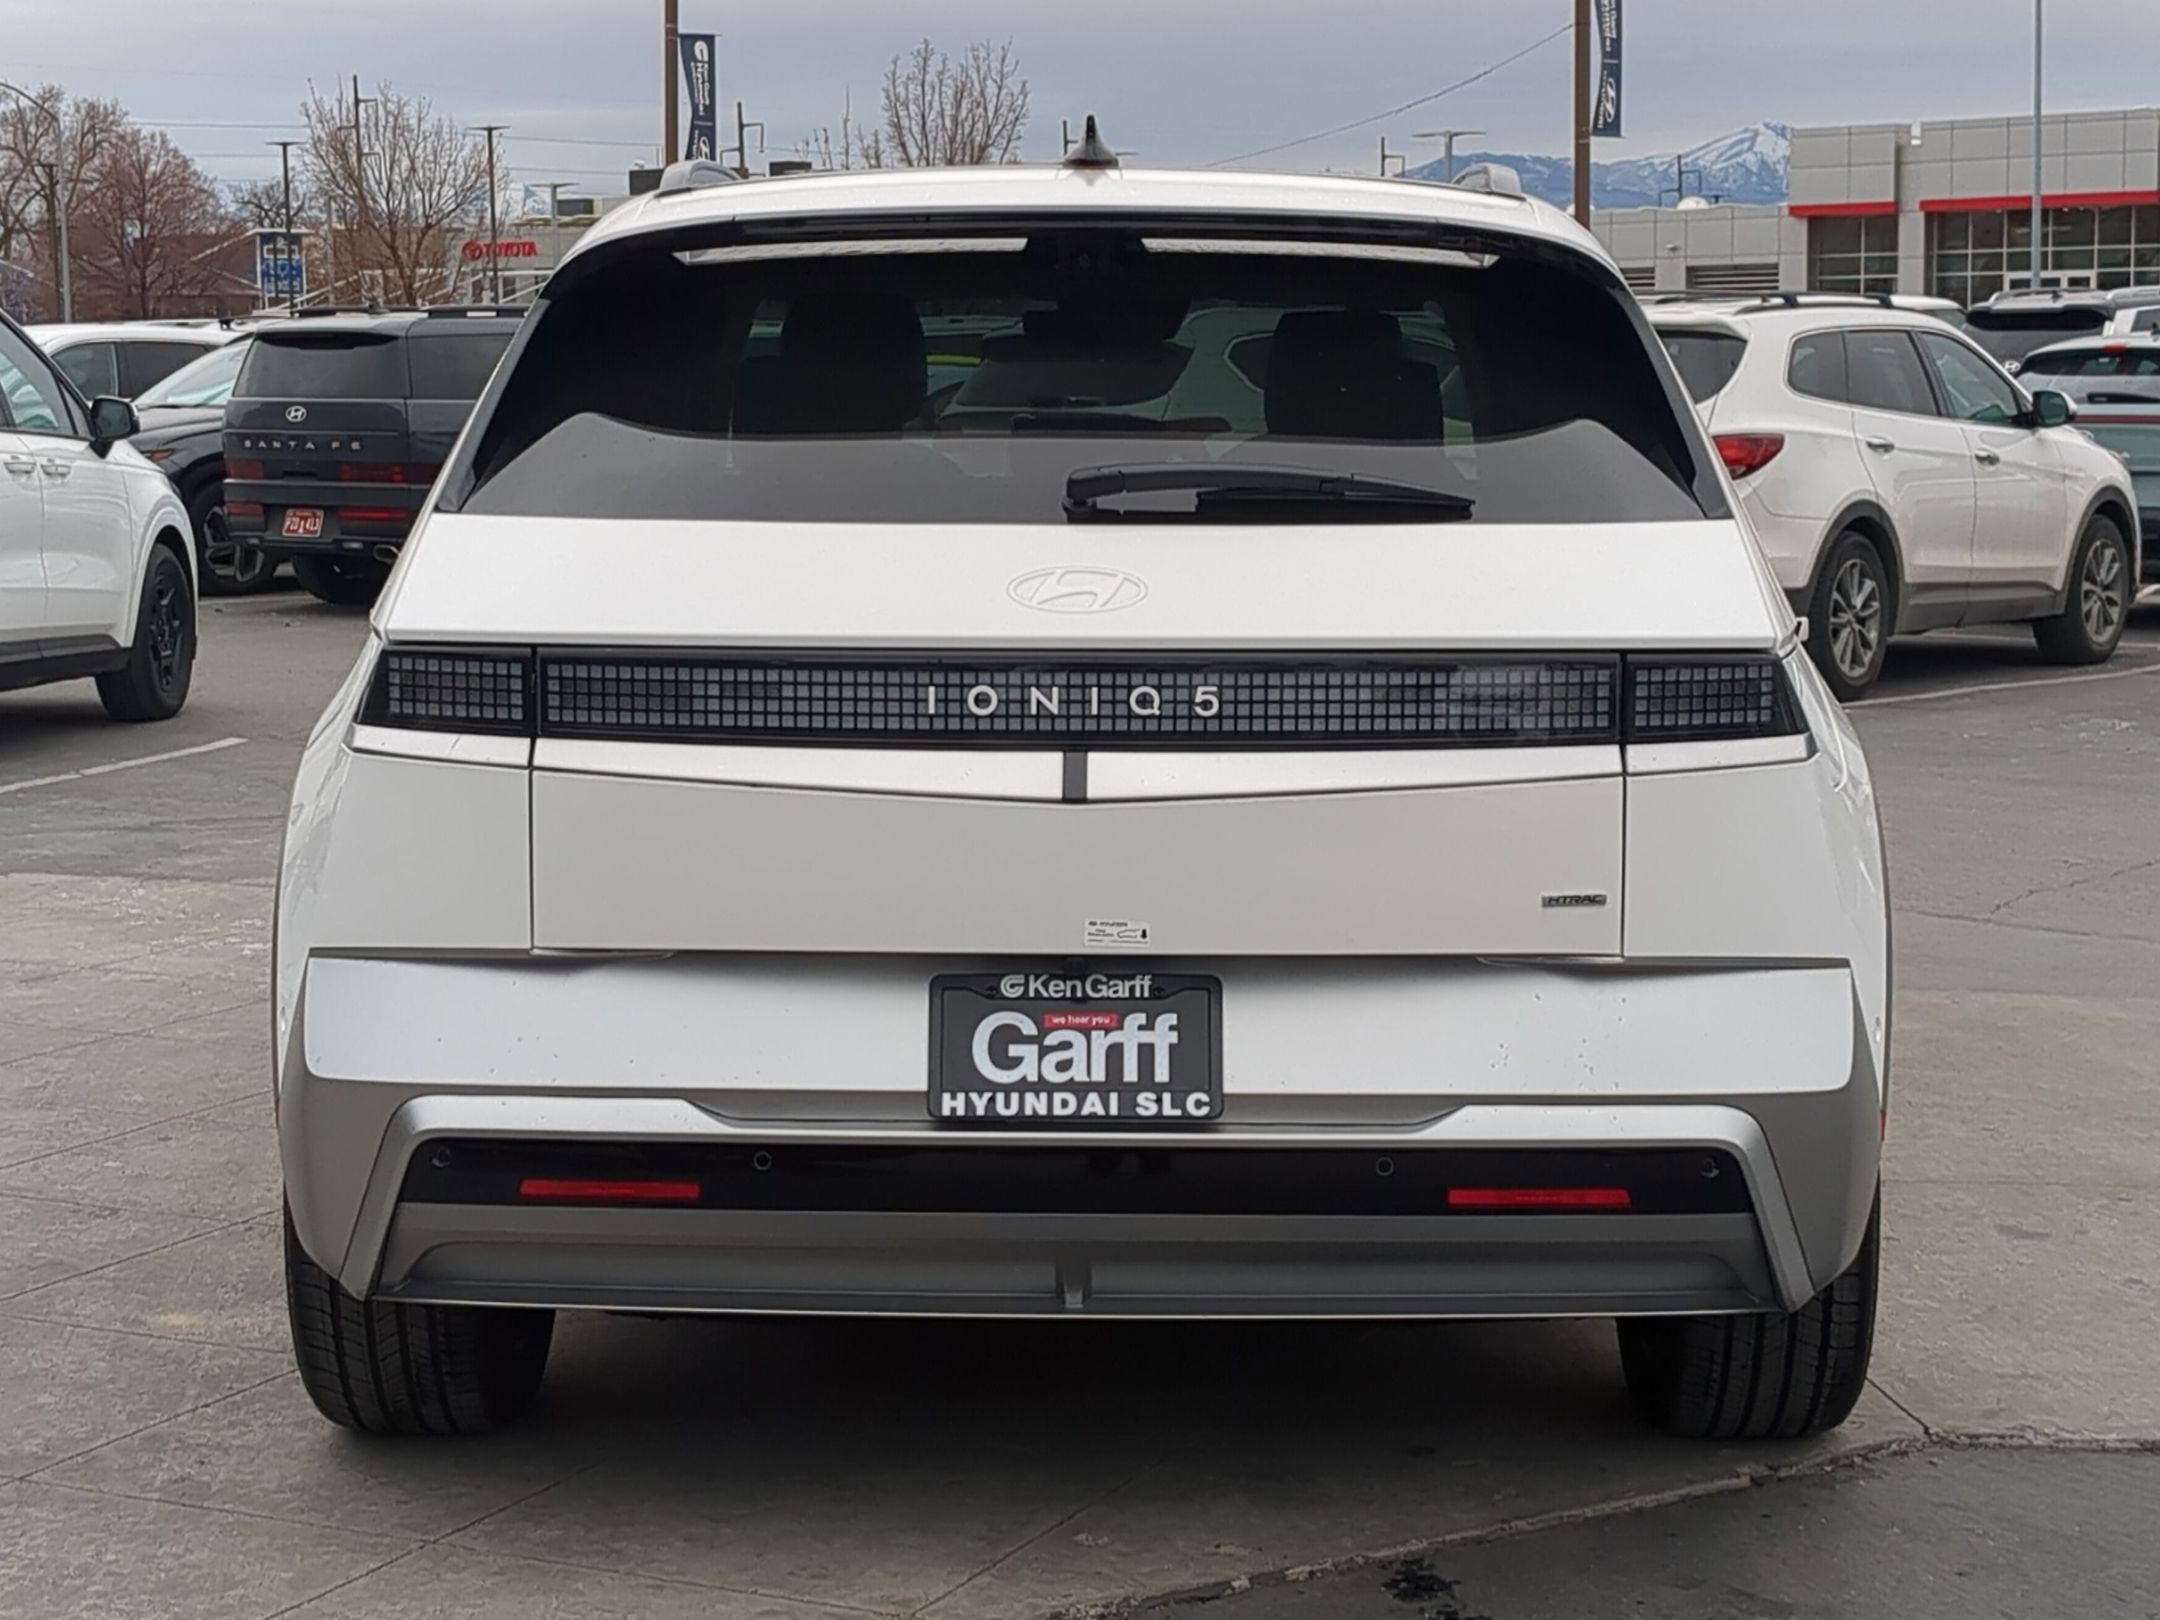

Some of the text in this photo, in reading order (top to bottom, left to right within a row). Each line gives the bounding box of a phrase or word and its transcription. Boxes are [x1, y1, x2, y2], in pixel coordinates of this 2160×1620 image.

[244, 440, 361, 450] SANTA FE
[1068, 1015, 1089, 1024] hear
[1091, 1016, 1111, 1026] you
[972, 1010, 1178, 1084] Garff
[941, 1091, 1211, 1117] HYUNDAI SLC
